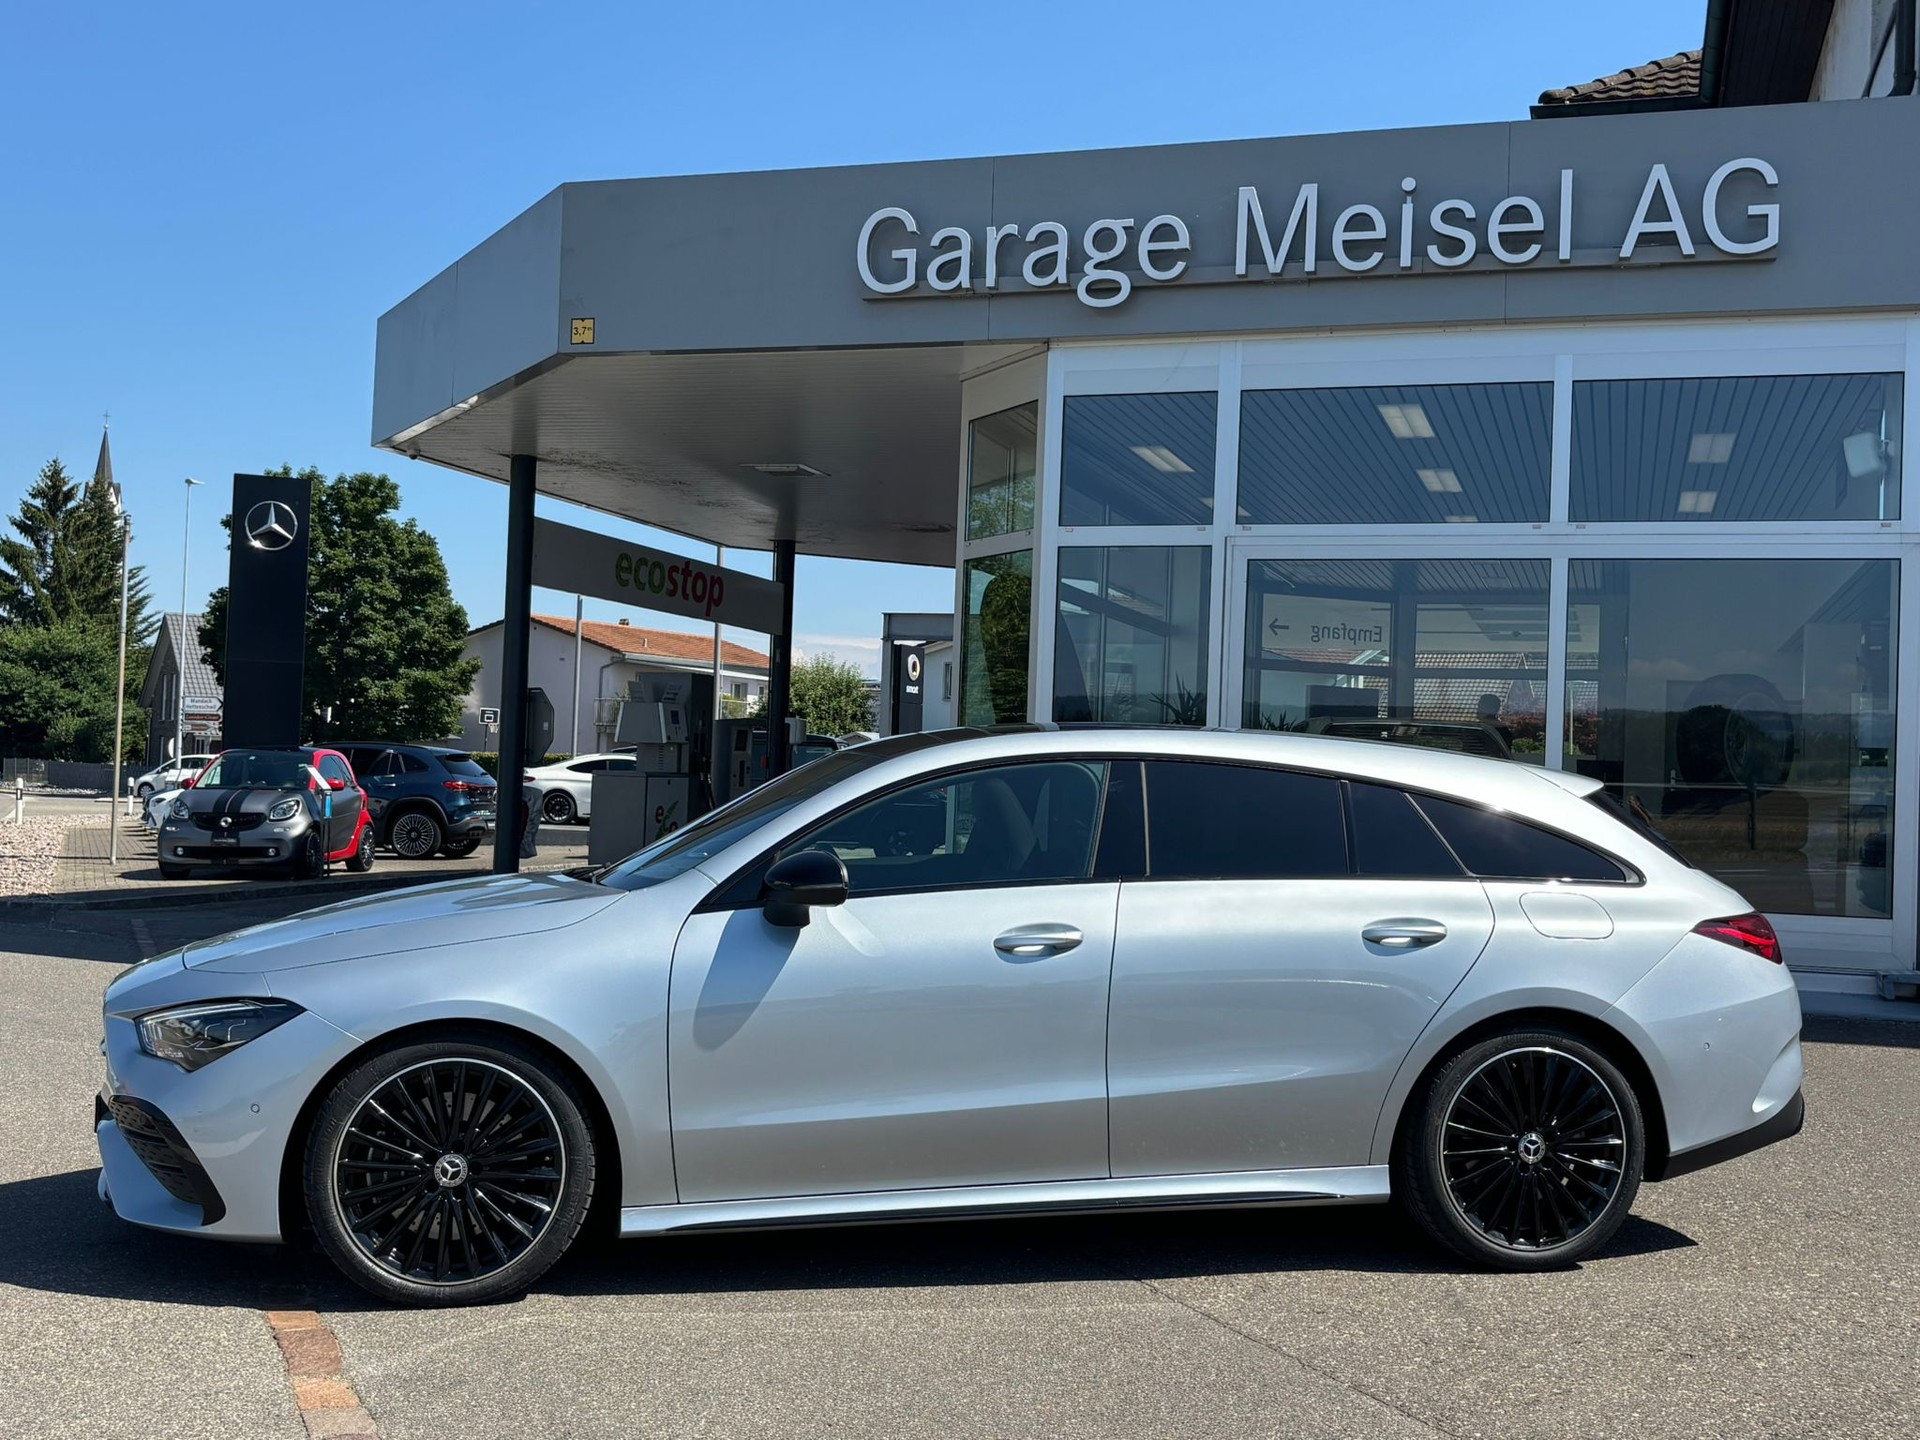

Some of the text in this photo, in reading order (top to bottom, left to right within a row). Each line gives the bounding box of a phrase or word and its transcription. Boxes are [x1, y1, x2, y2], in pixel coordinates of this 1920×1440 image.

[857, 157, 1780, 308] Garage Meisel AG
[615, 552, 724, 617] ecostop
